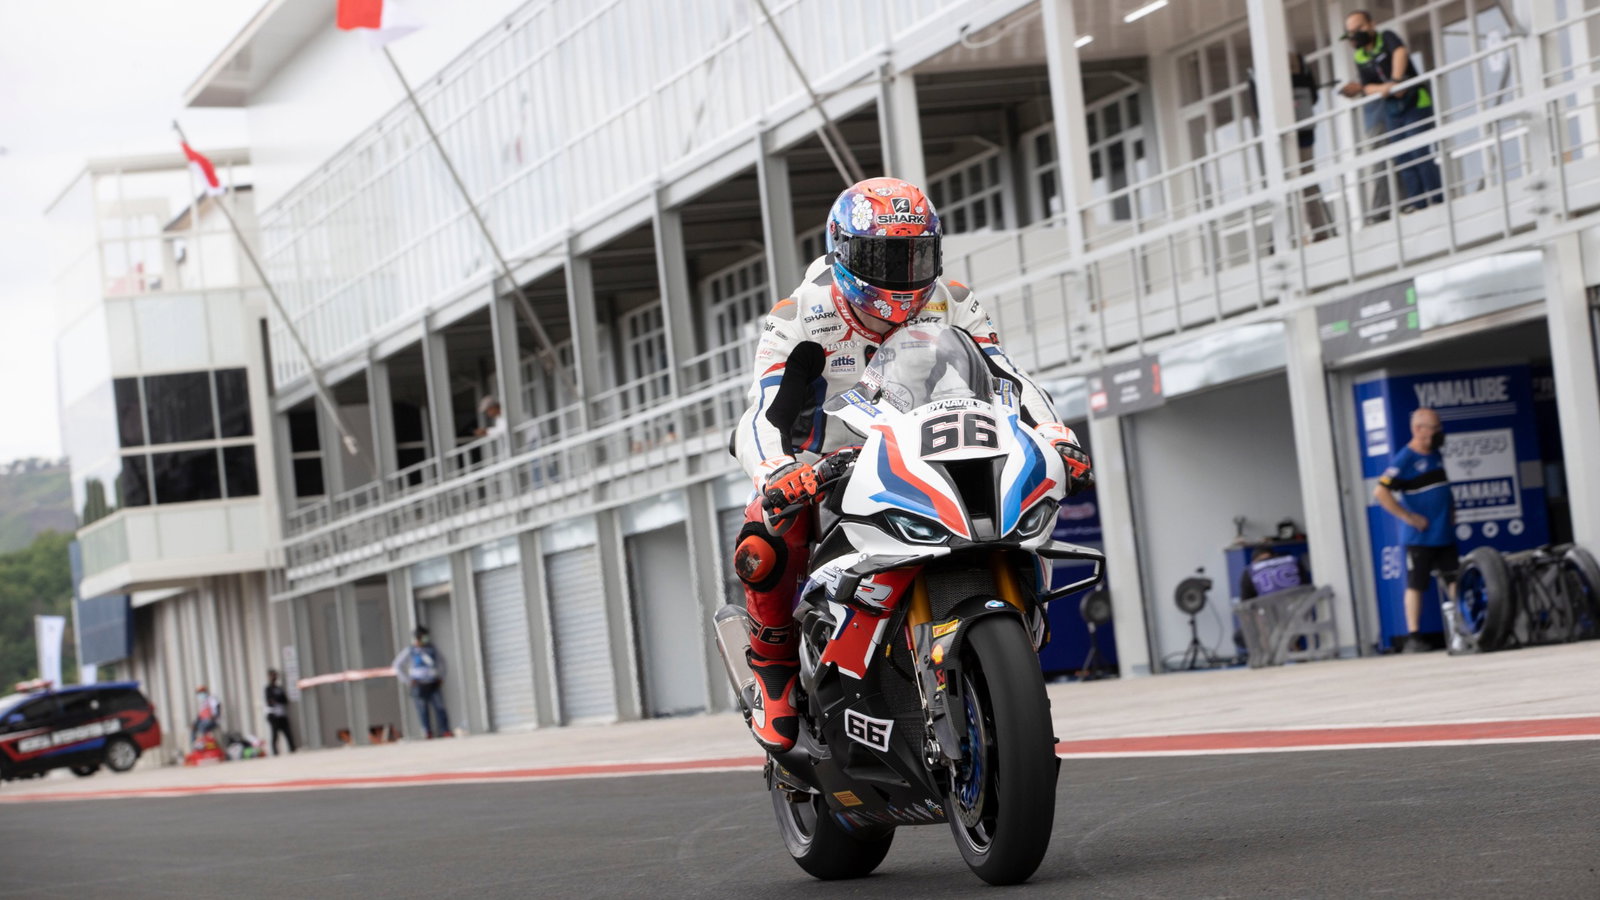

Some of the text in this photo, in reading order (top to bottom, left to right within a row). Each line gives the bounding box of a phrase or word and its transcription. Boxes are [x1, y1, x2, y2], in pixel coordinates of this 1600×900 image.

[877, 214, 925, 224] SHARK
[804, 309, 838, 324] SHARK
[836, 295, 877, 340] DAINESE
[811, 323, 843, 336] DYNAVOLT
[830, 354, 856, 368] attis
[1413, 375, 1510, 408] YAMALUBE
[917, 399, 983, 412] DYNAVOLT
[919, 412, 1000, 458] 66
[1451, 478, 1512, 501] YAMAHA
[849, 713, 887, 748] 66
